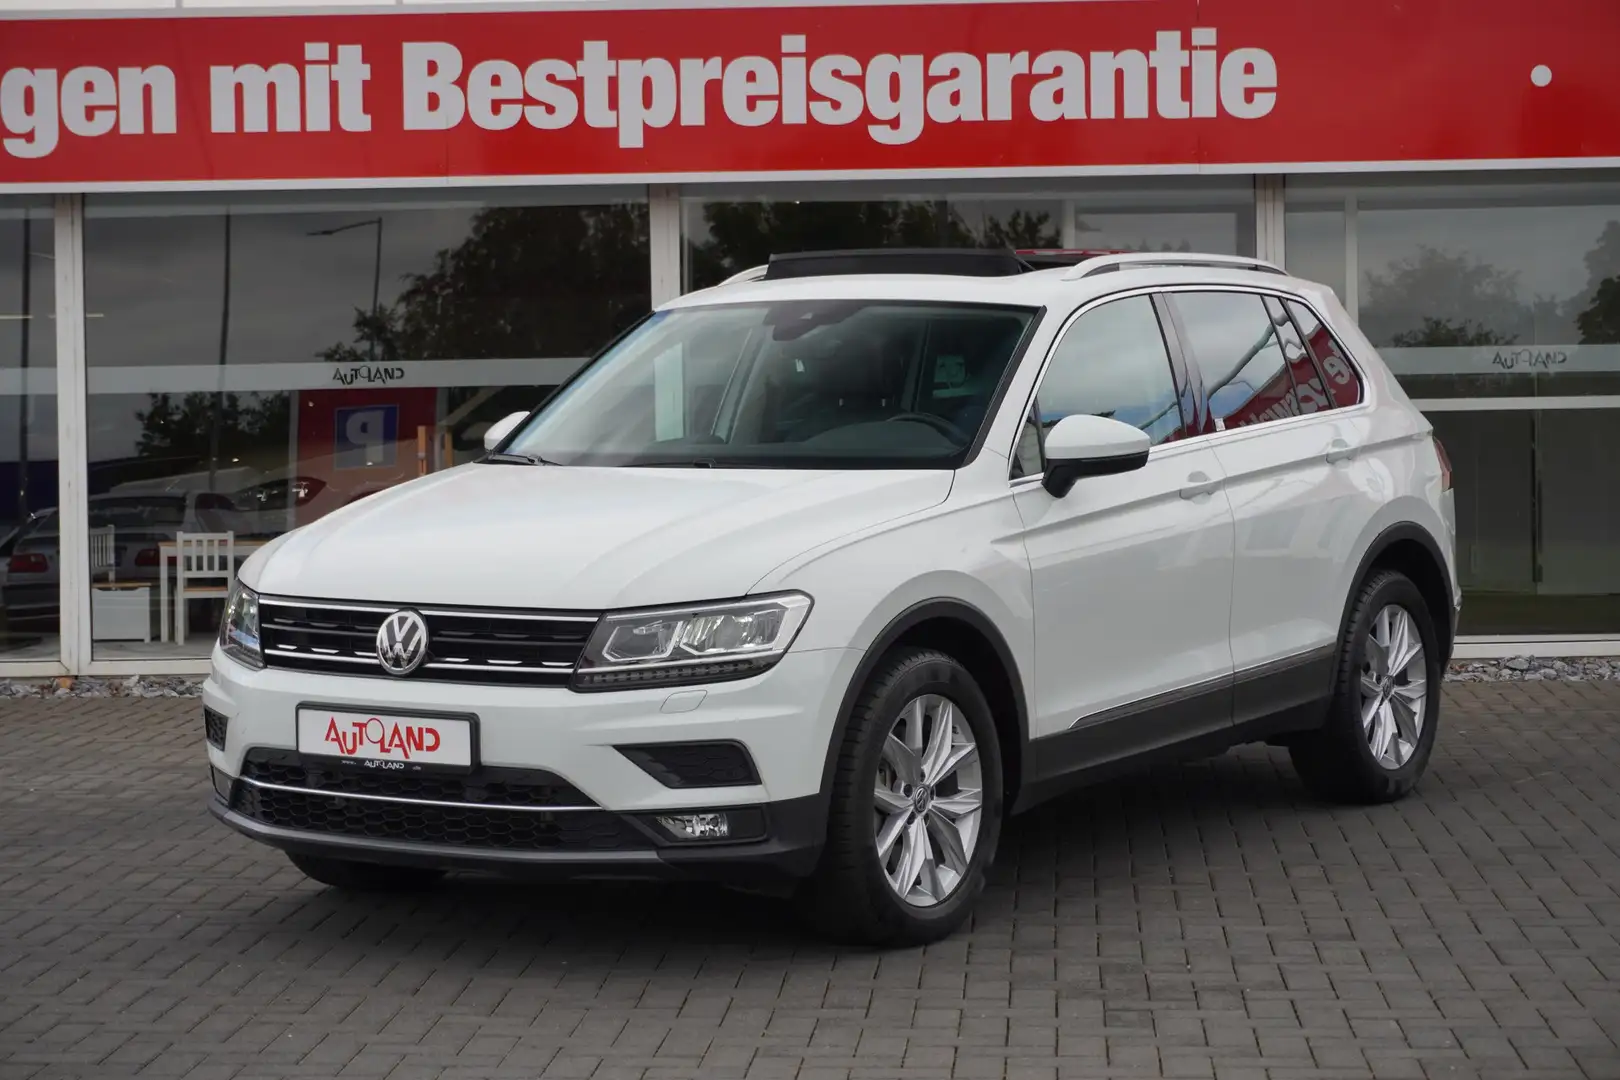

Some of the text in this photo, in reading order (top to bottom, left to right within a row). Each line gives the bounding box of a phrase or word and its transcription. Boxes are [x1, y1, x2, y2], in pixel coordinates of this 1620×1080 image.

[0, 27, 1278, 159] gen mit Bestpreisgarantie
[324, 716, 441, 759] AUTOLAND
